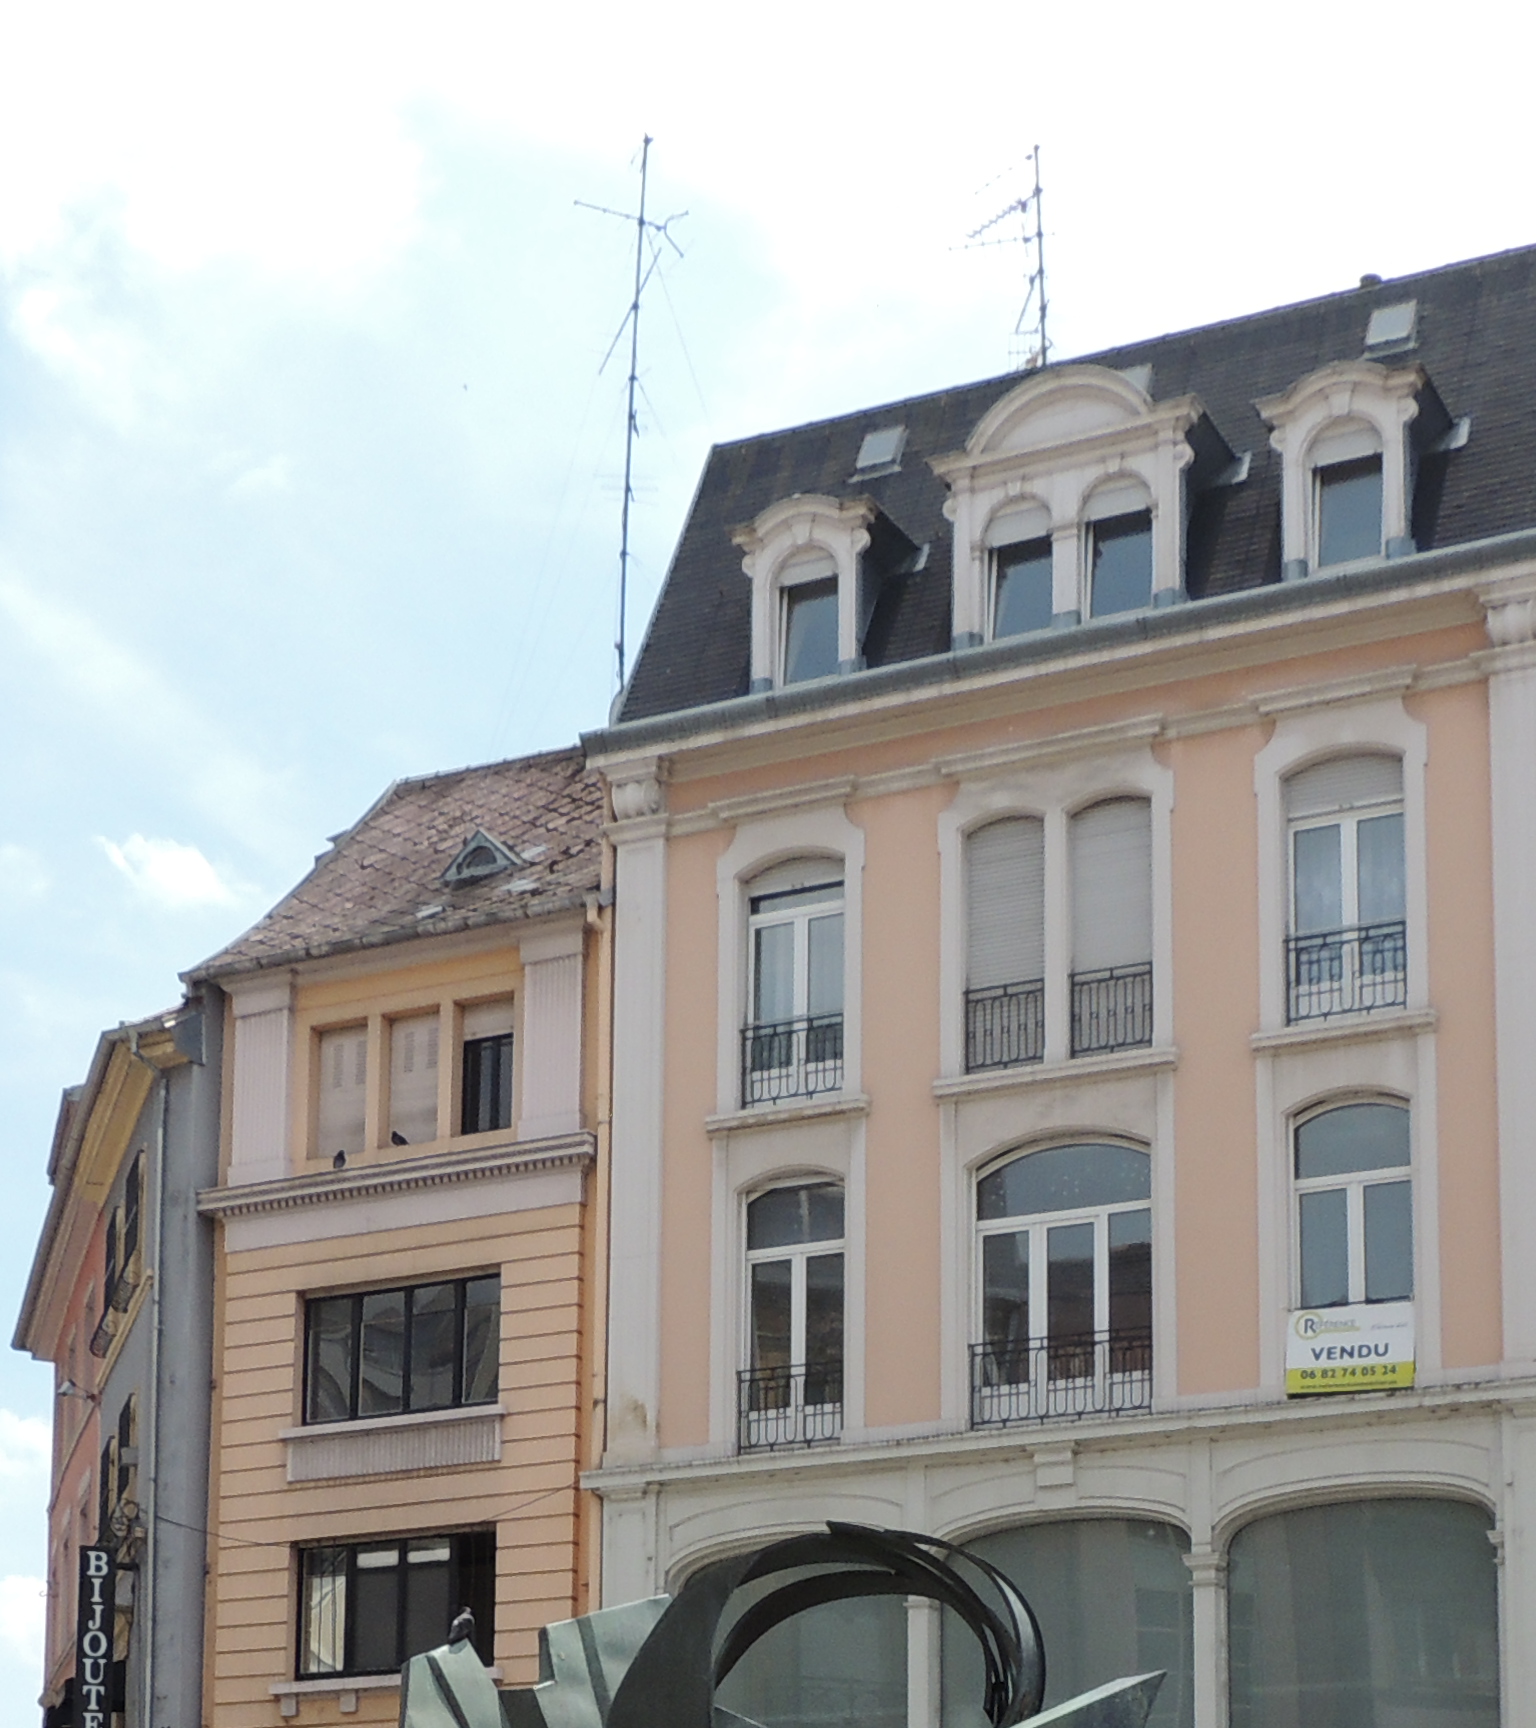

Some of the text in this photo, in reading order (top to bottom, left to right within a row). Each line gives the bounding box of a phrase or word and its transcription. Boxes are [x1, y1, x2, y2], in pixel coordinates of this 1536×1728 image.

[1310, 1342, 1390, 1361] VENDU
[1300, 1364, 1398, 1380] 06 82 74 05 24
